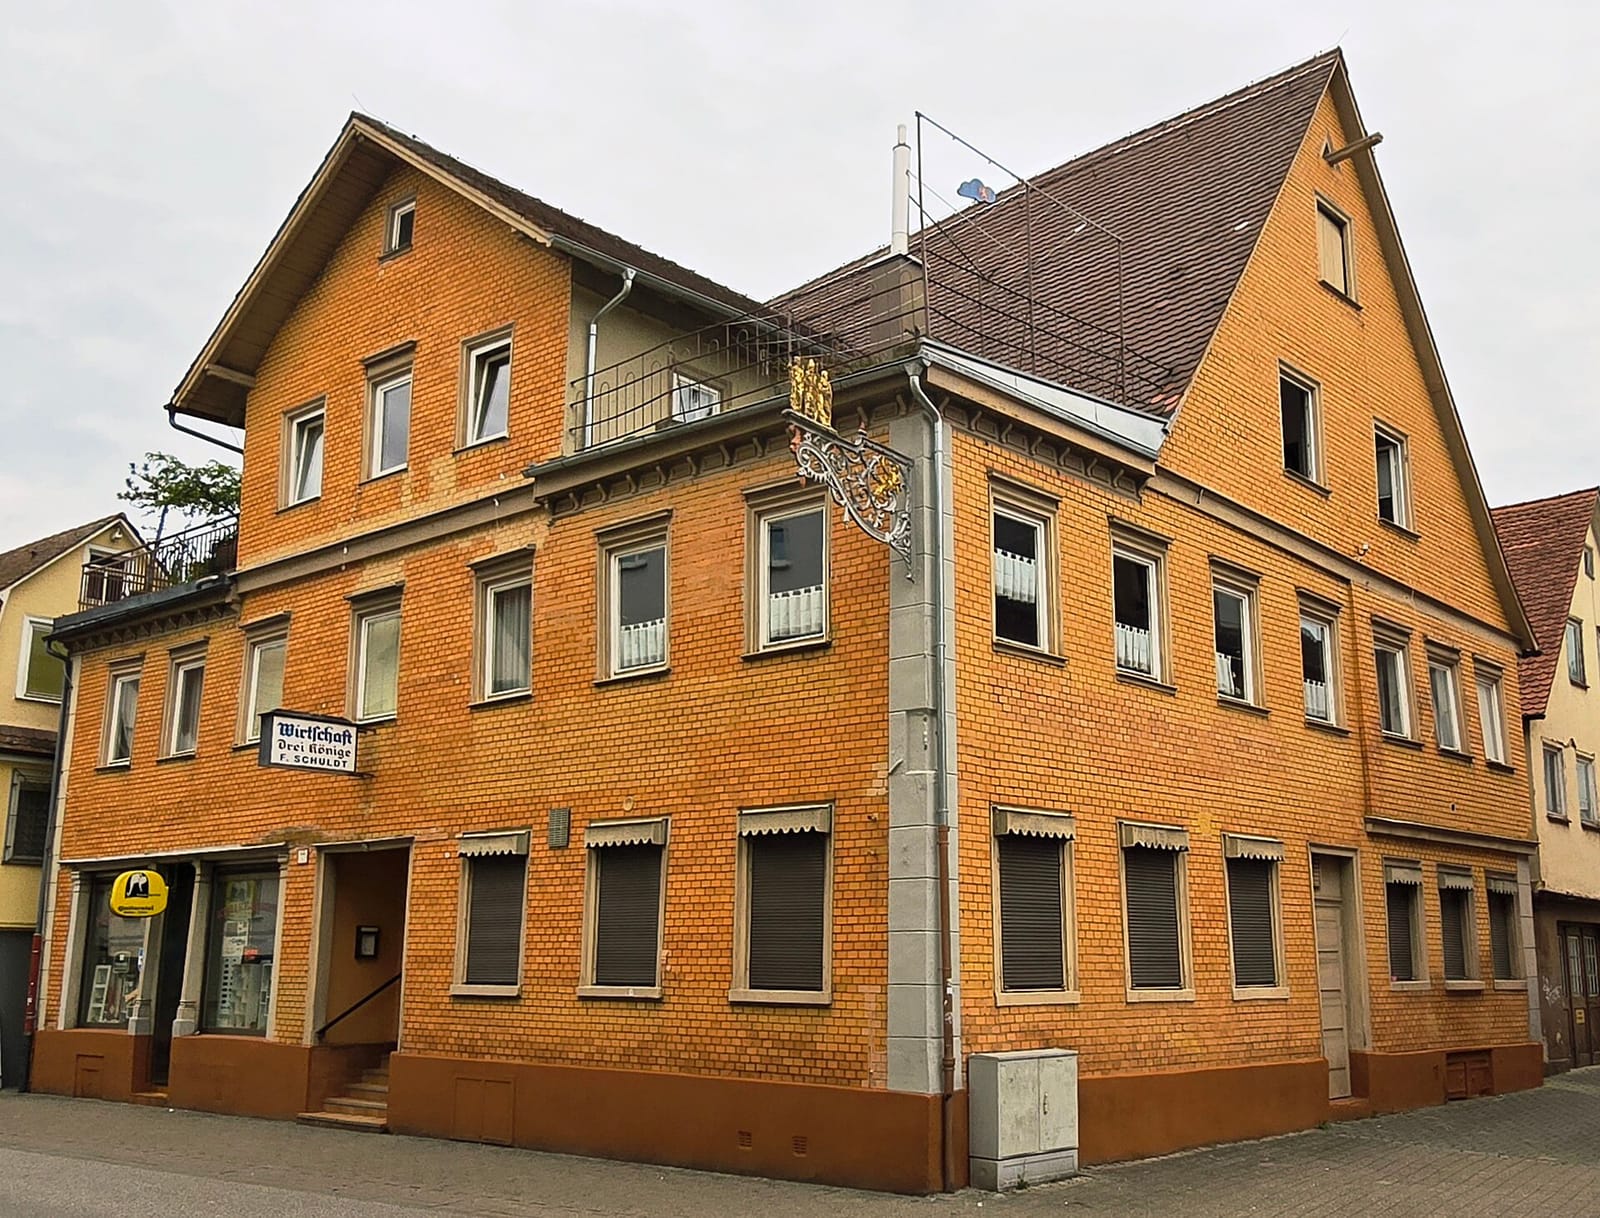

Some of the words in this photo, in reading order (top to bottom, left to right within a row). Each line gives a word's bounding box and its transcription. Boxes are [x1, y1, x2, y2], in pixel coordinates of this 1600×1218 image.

[277, 738, 304, 753] Drei
[309, 742, 352, 759] Könige
[280, 753, 289, 762] F.
[294, 755, 348, 768] SCHULDT
